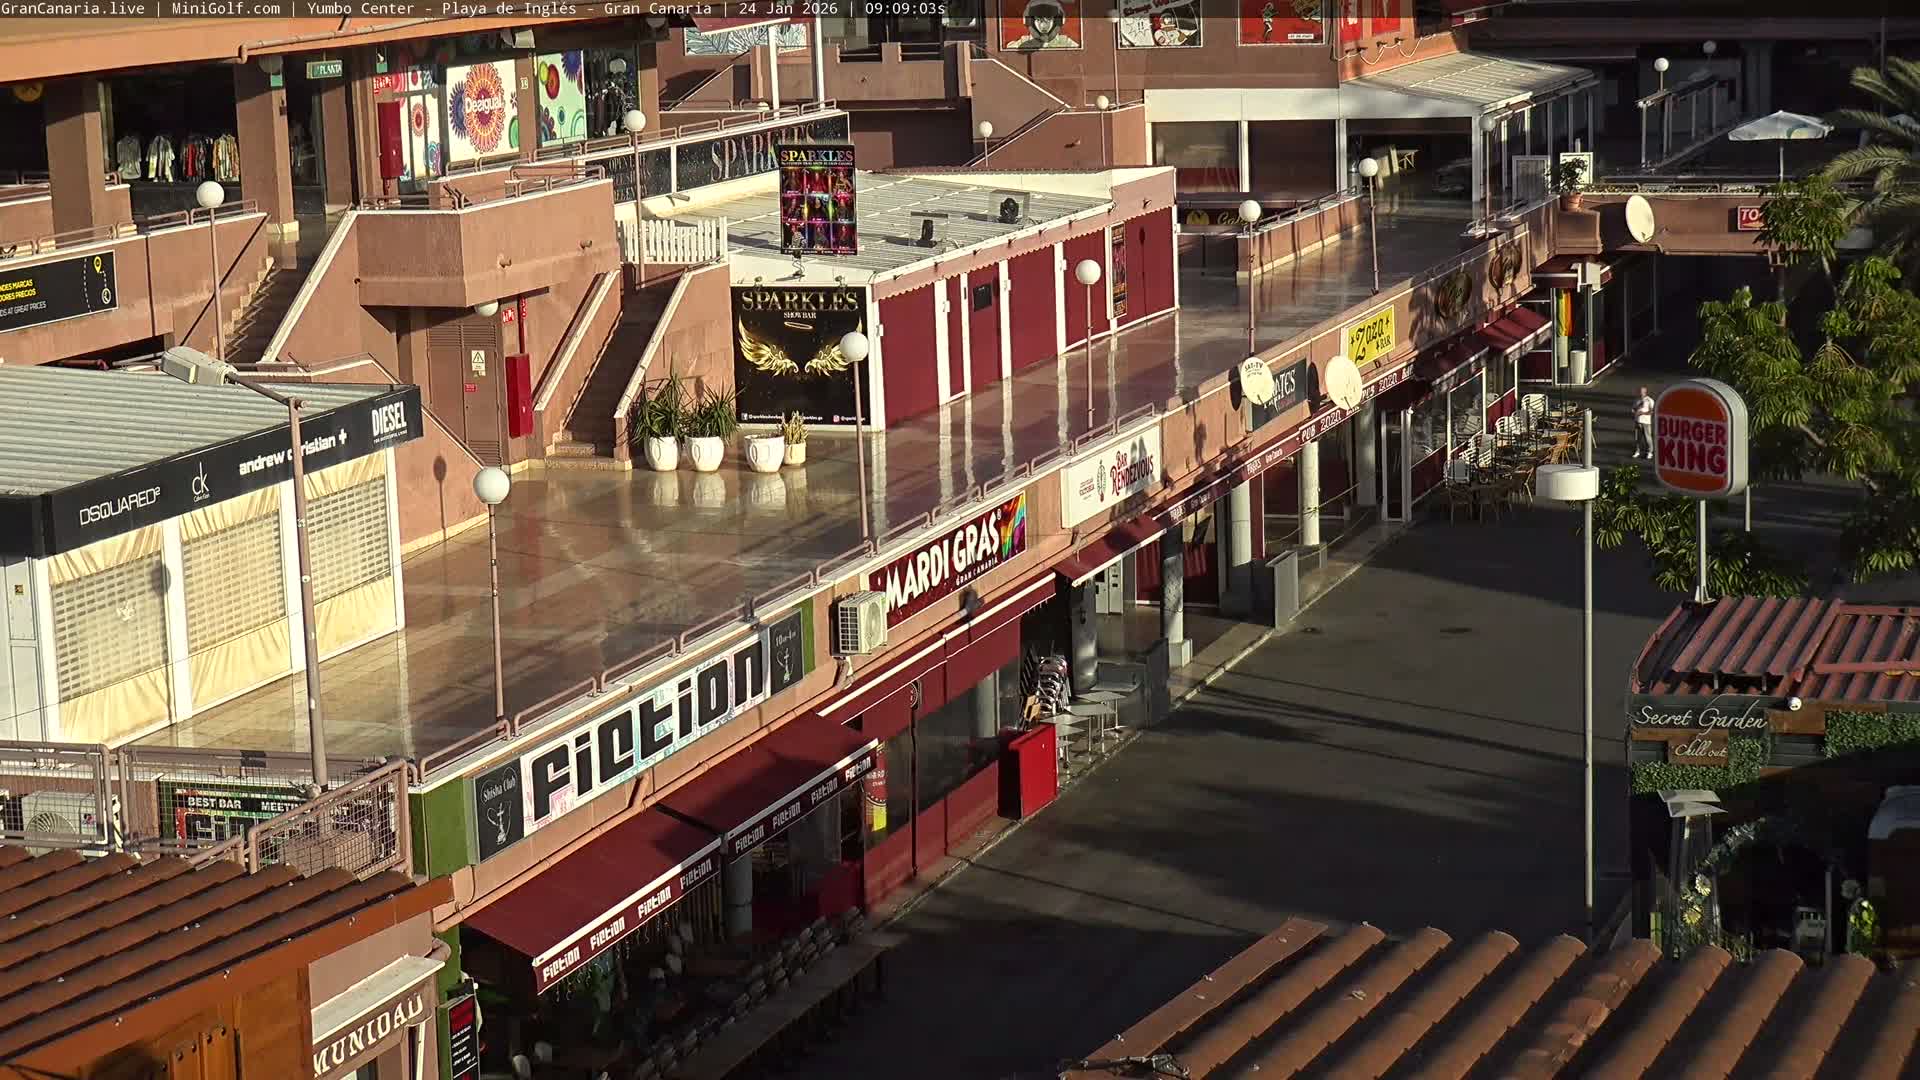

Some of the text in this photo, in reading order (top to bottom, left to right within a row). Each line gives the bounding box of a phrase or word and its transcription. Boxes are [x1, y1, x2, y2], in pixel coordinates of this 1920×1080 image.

[780, 150, 854, 162] SPARKLES
[741, 291, 859, 311] SPARKLES
[1379, 335, 1392, 349] BAR
[371, 400, 408, 437] DIESEL
[1301, 424, 1316, 442] PUB
[1657, 417, 1728, 446] BURGER
[239, 450, 285, 476] andrew
[286, 433, 336, 461] cristian
[1115, 450, 1128, 470] BAR
[1657, 437, 1728, 474] KING
[191, 461, 210, 496] ck
[1109, 454, 1154, 496] RENDEZVOUS
[886, 539, 950, 611] MARDI
[955, 556, 998, 586] GRAN CANARIA
[1635, 699, 1768, 736] Secret Garden
[1674, 738, 1728, 757] Chill out
[187, 796, 216, 809] BEST
[219, 798, 242, 810] BAR
